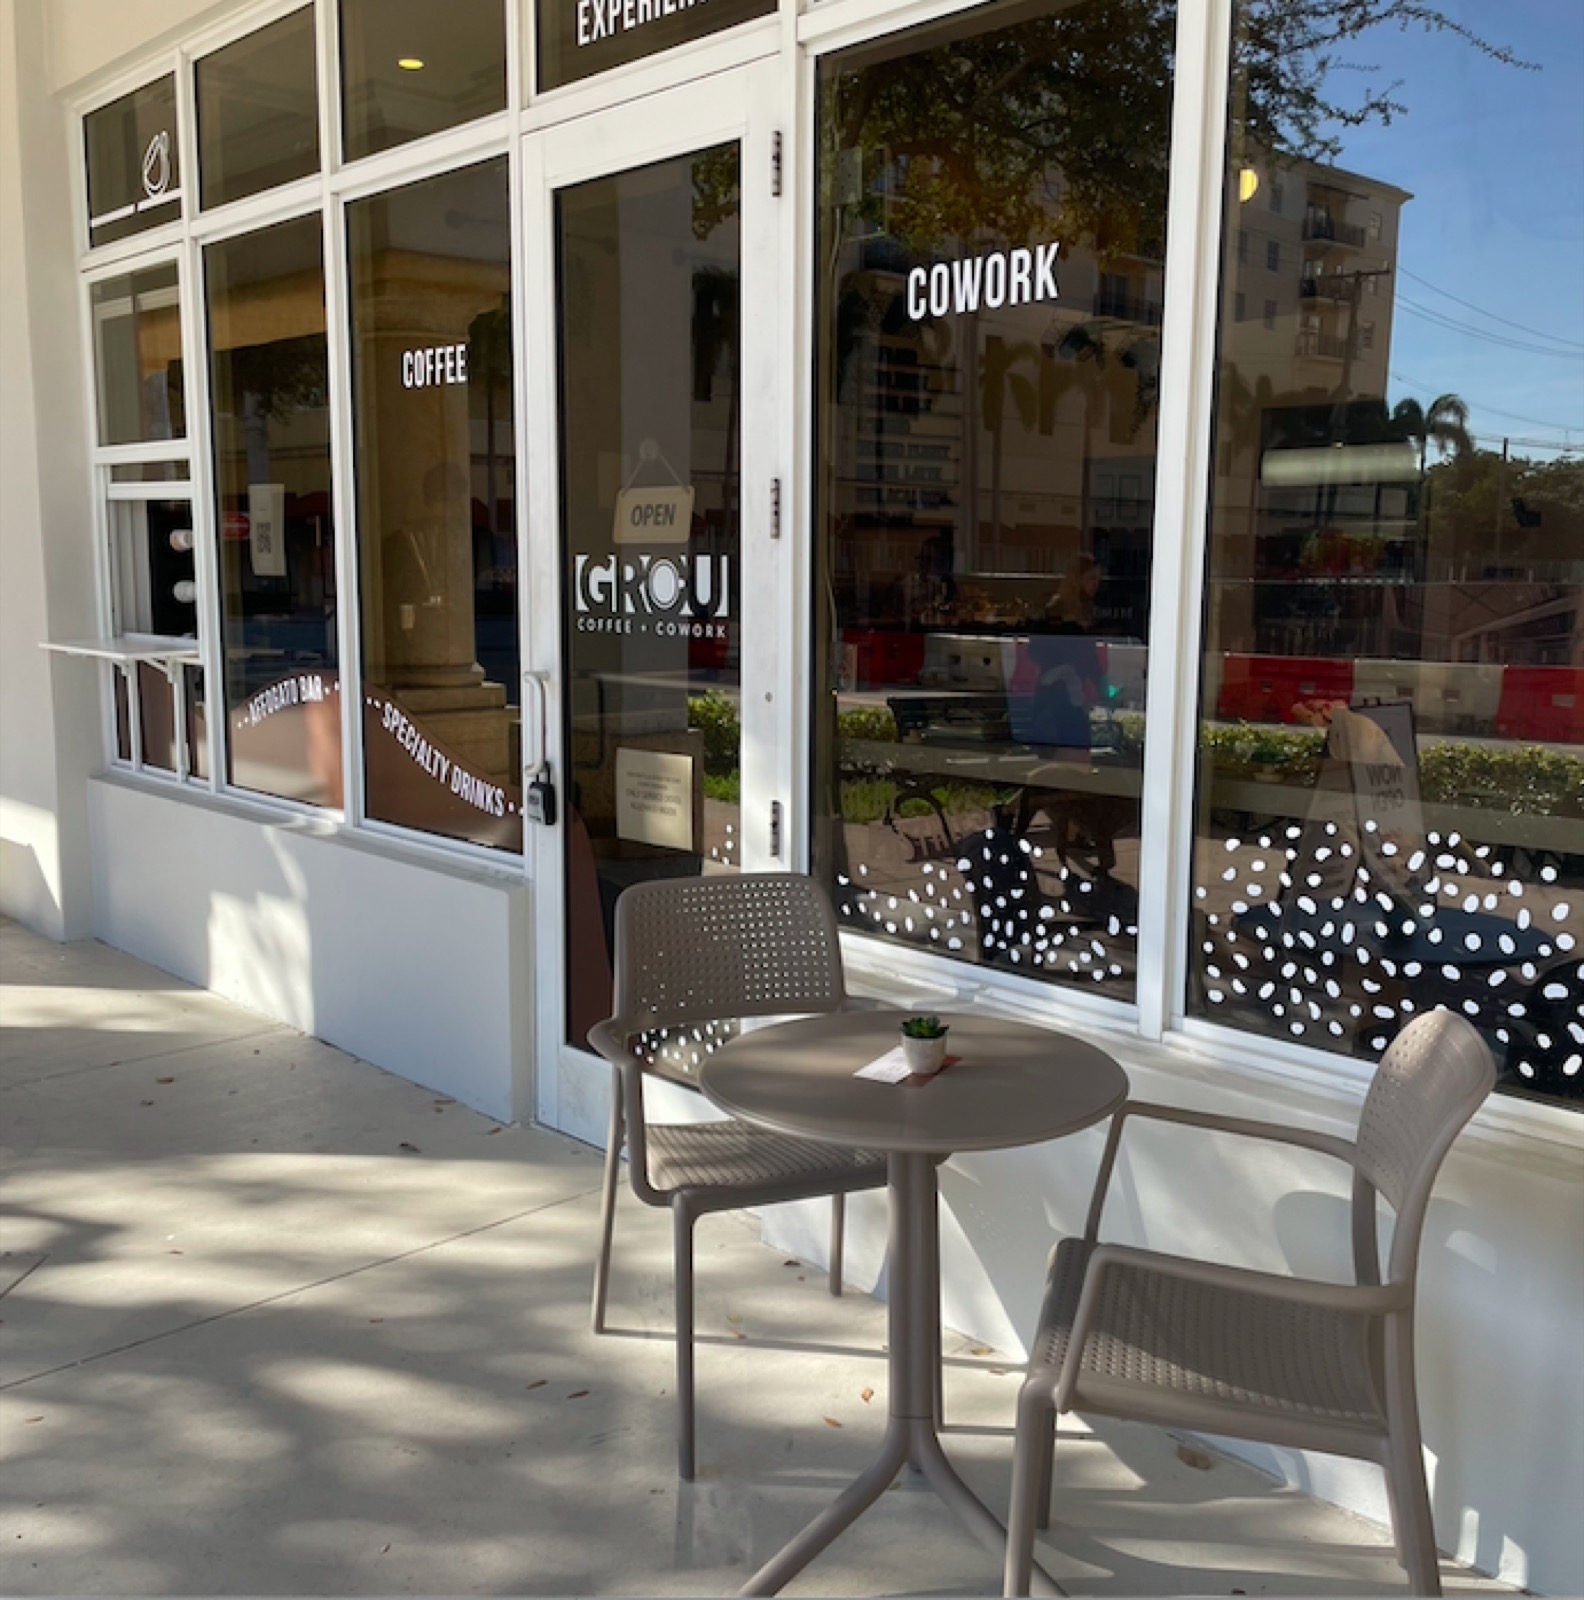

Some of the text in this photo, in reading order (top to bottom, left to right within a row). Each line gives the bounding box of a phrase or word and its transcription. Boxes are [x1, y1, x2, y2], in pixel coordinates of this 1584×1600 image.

[907, 241, 1060, 321] COWORK
[402, 343, 467, 388] COFFEE
[631, 503, 676, 527] OPEN
[577, 618, 726, 638] COFFEE COWORK
[382, 701, 505, 817] SPECIALTY DRINKS
